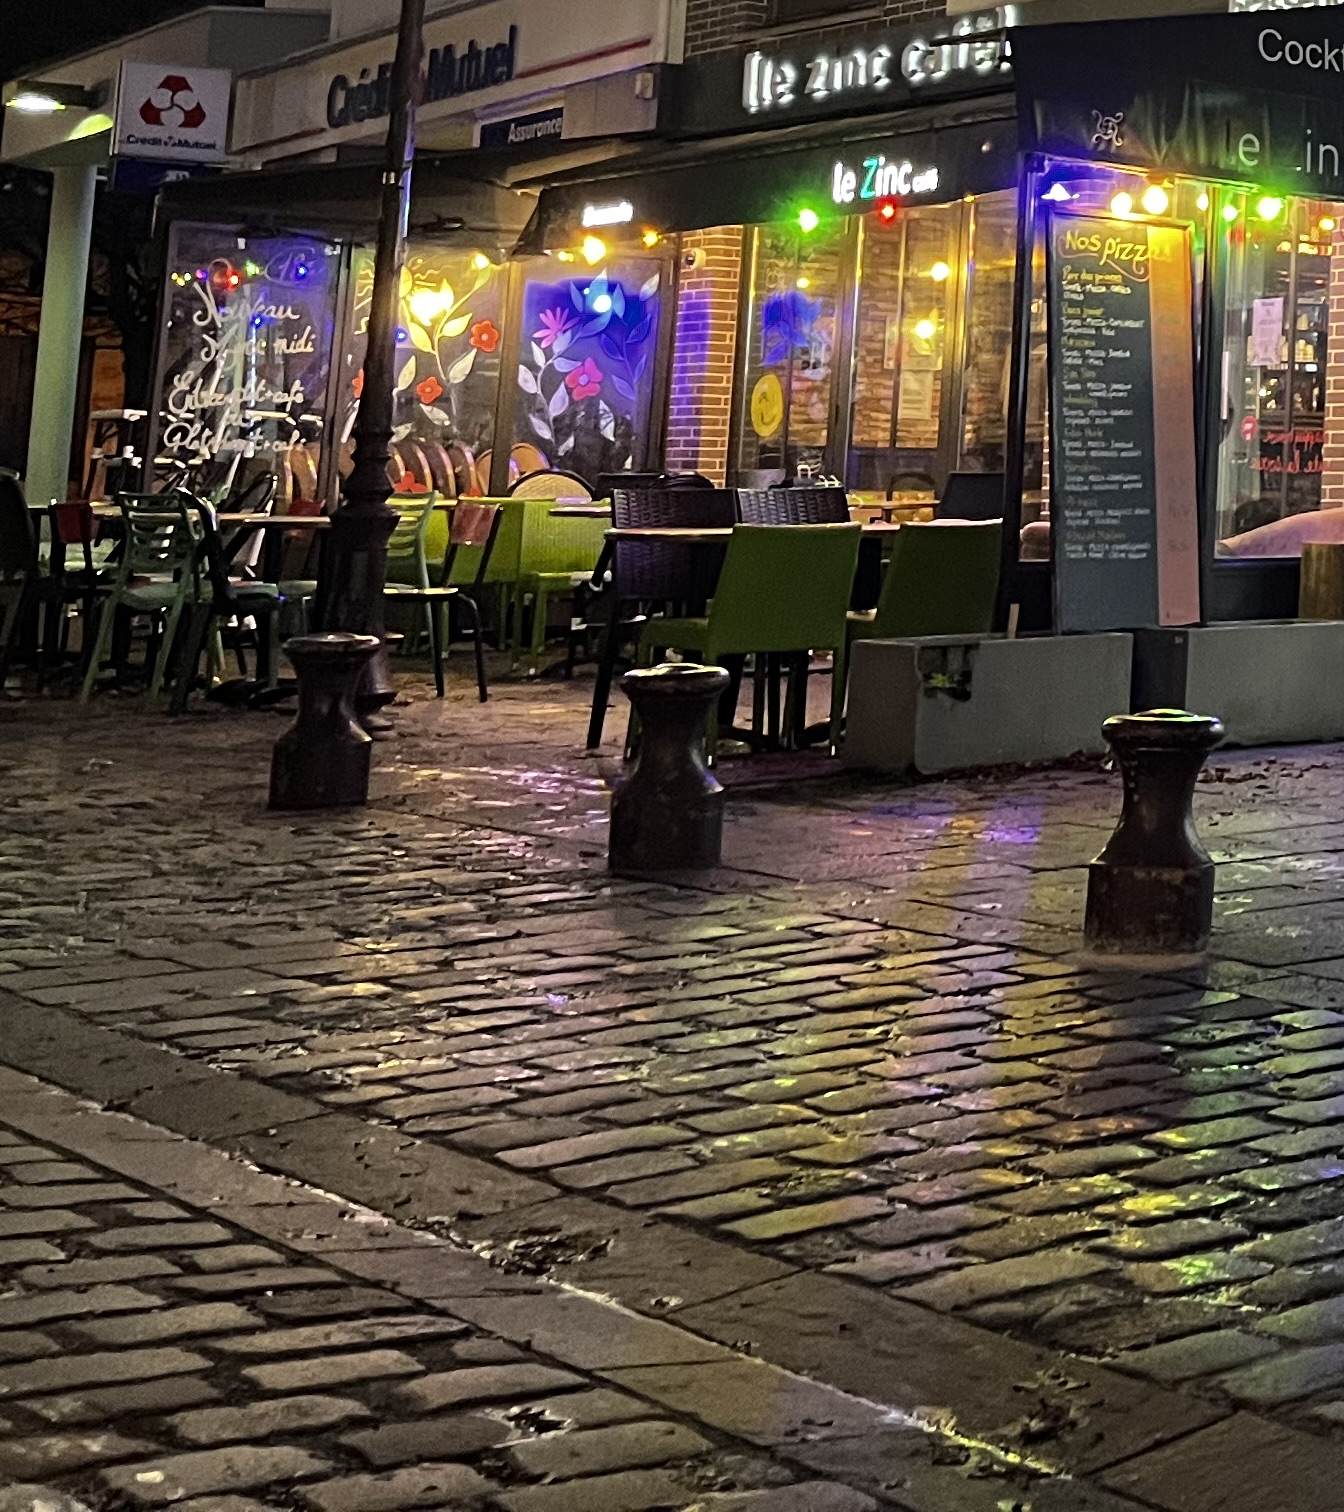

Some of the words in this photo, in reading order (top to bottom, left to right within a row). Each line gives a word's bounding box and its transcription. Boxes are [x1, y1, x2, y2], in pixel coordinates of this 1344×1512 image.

[428, 24, 518, 101] Mutuel
[805, 56, 893, 100] zinc
[832, 161, 857, 203] le
[860, 155, 912, 200] Zinc
[1065, 229, 1102, 252] Nos
